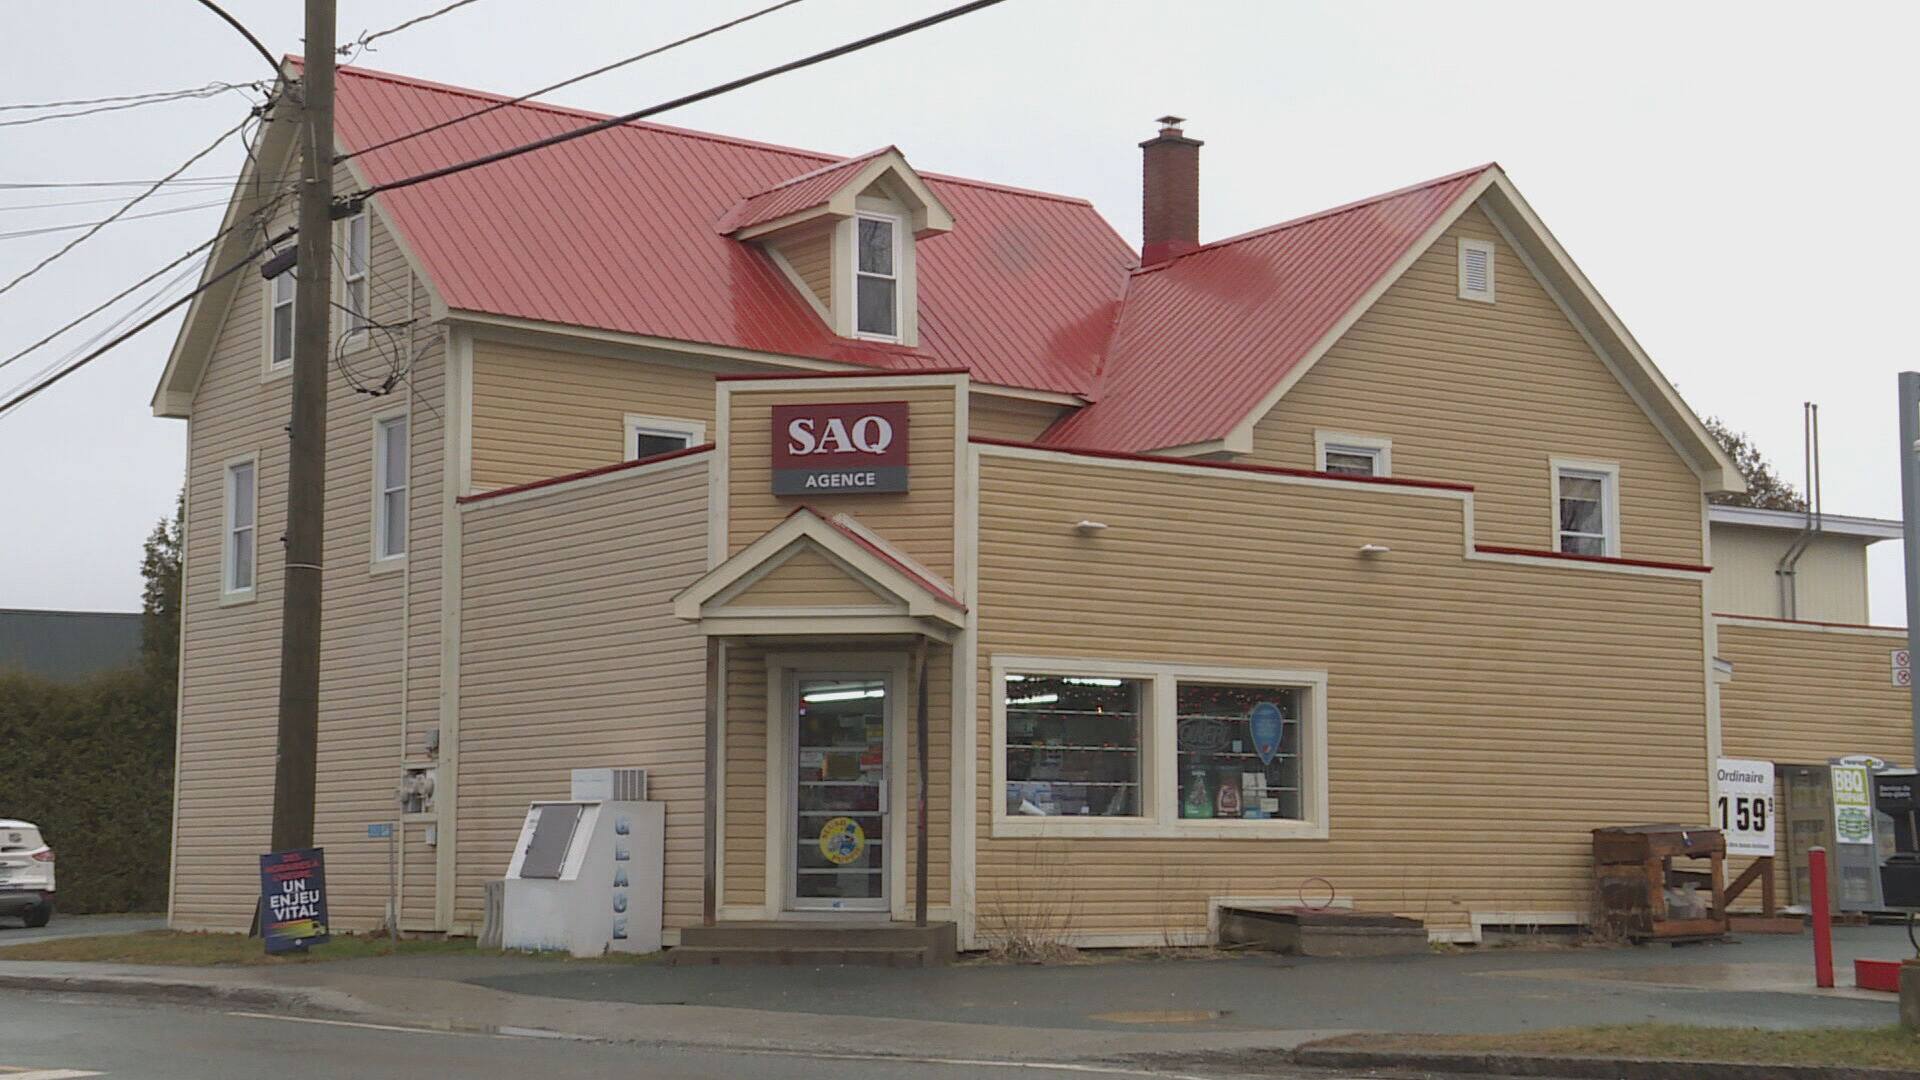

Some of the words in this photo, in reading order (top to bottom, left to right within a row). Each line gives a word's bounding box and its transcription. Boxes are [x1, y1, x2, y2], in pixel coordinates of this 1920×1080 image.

[788, 415, 893, 456] SAQ
[805, 472, 876, 488] AGENCE
[1717, 769, 1764, 783] Ordinaire
[1835, 770, 1863, 791] BBQ
[283, 878, 305, 893] UN
[270, 890, 319, 908] ENJEU
[274, 904, 318, 920] VITAL
